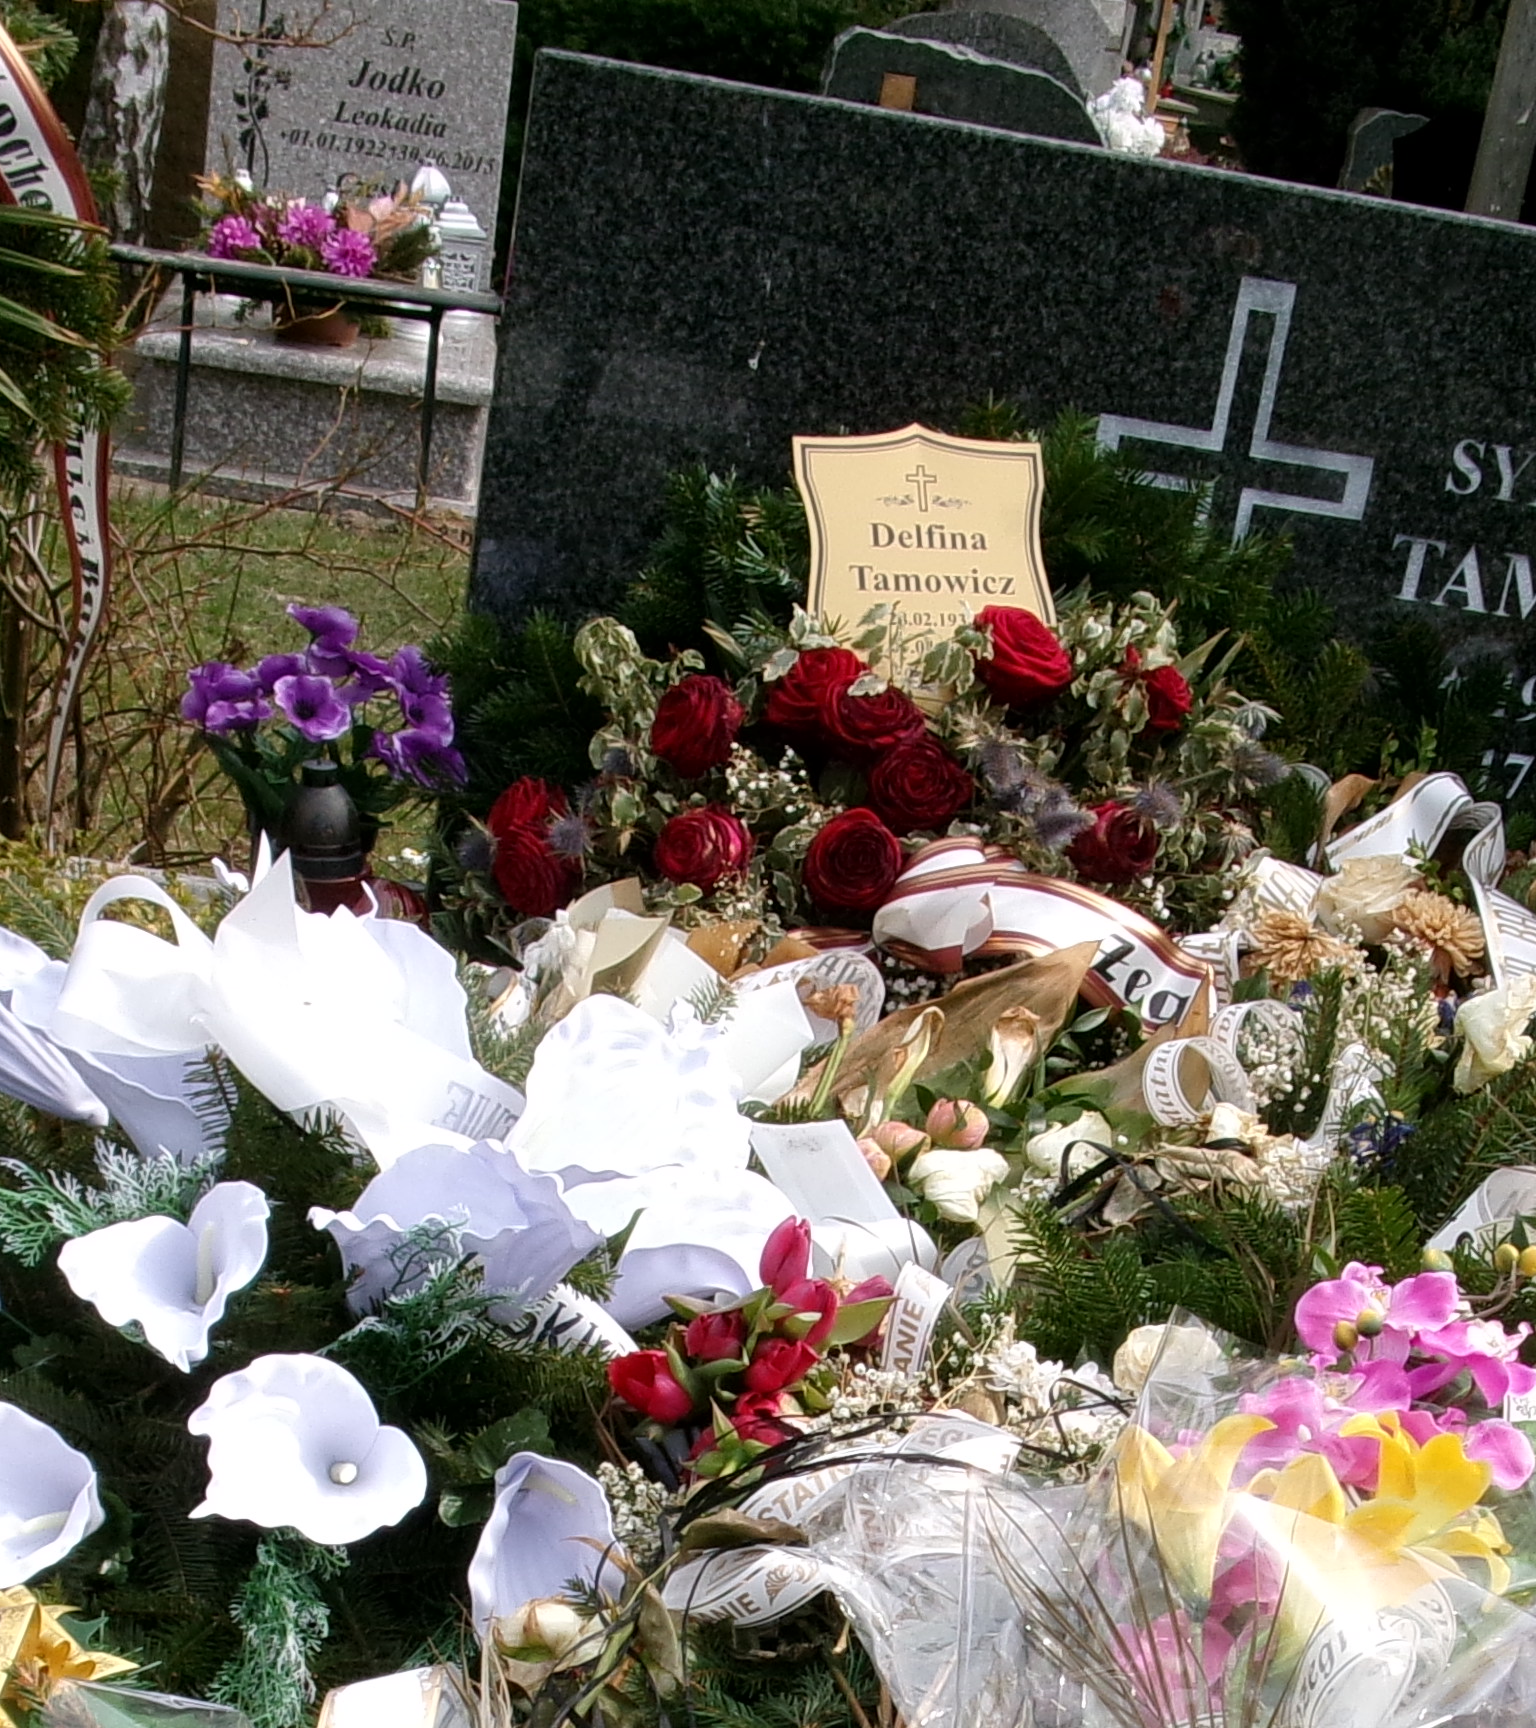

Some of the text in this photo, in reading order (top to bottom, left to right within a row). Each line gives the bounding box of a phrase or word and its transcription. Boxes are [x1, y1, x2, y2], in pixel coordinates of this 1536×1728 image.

[348, 57, 446, 100] Jodko
[333, 100, 448, 138] Leokadia
[869, 522, 987, 551] Delfina
[848, 564, 1016, 595] Tamowicz
